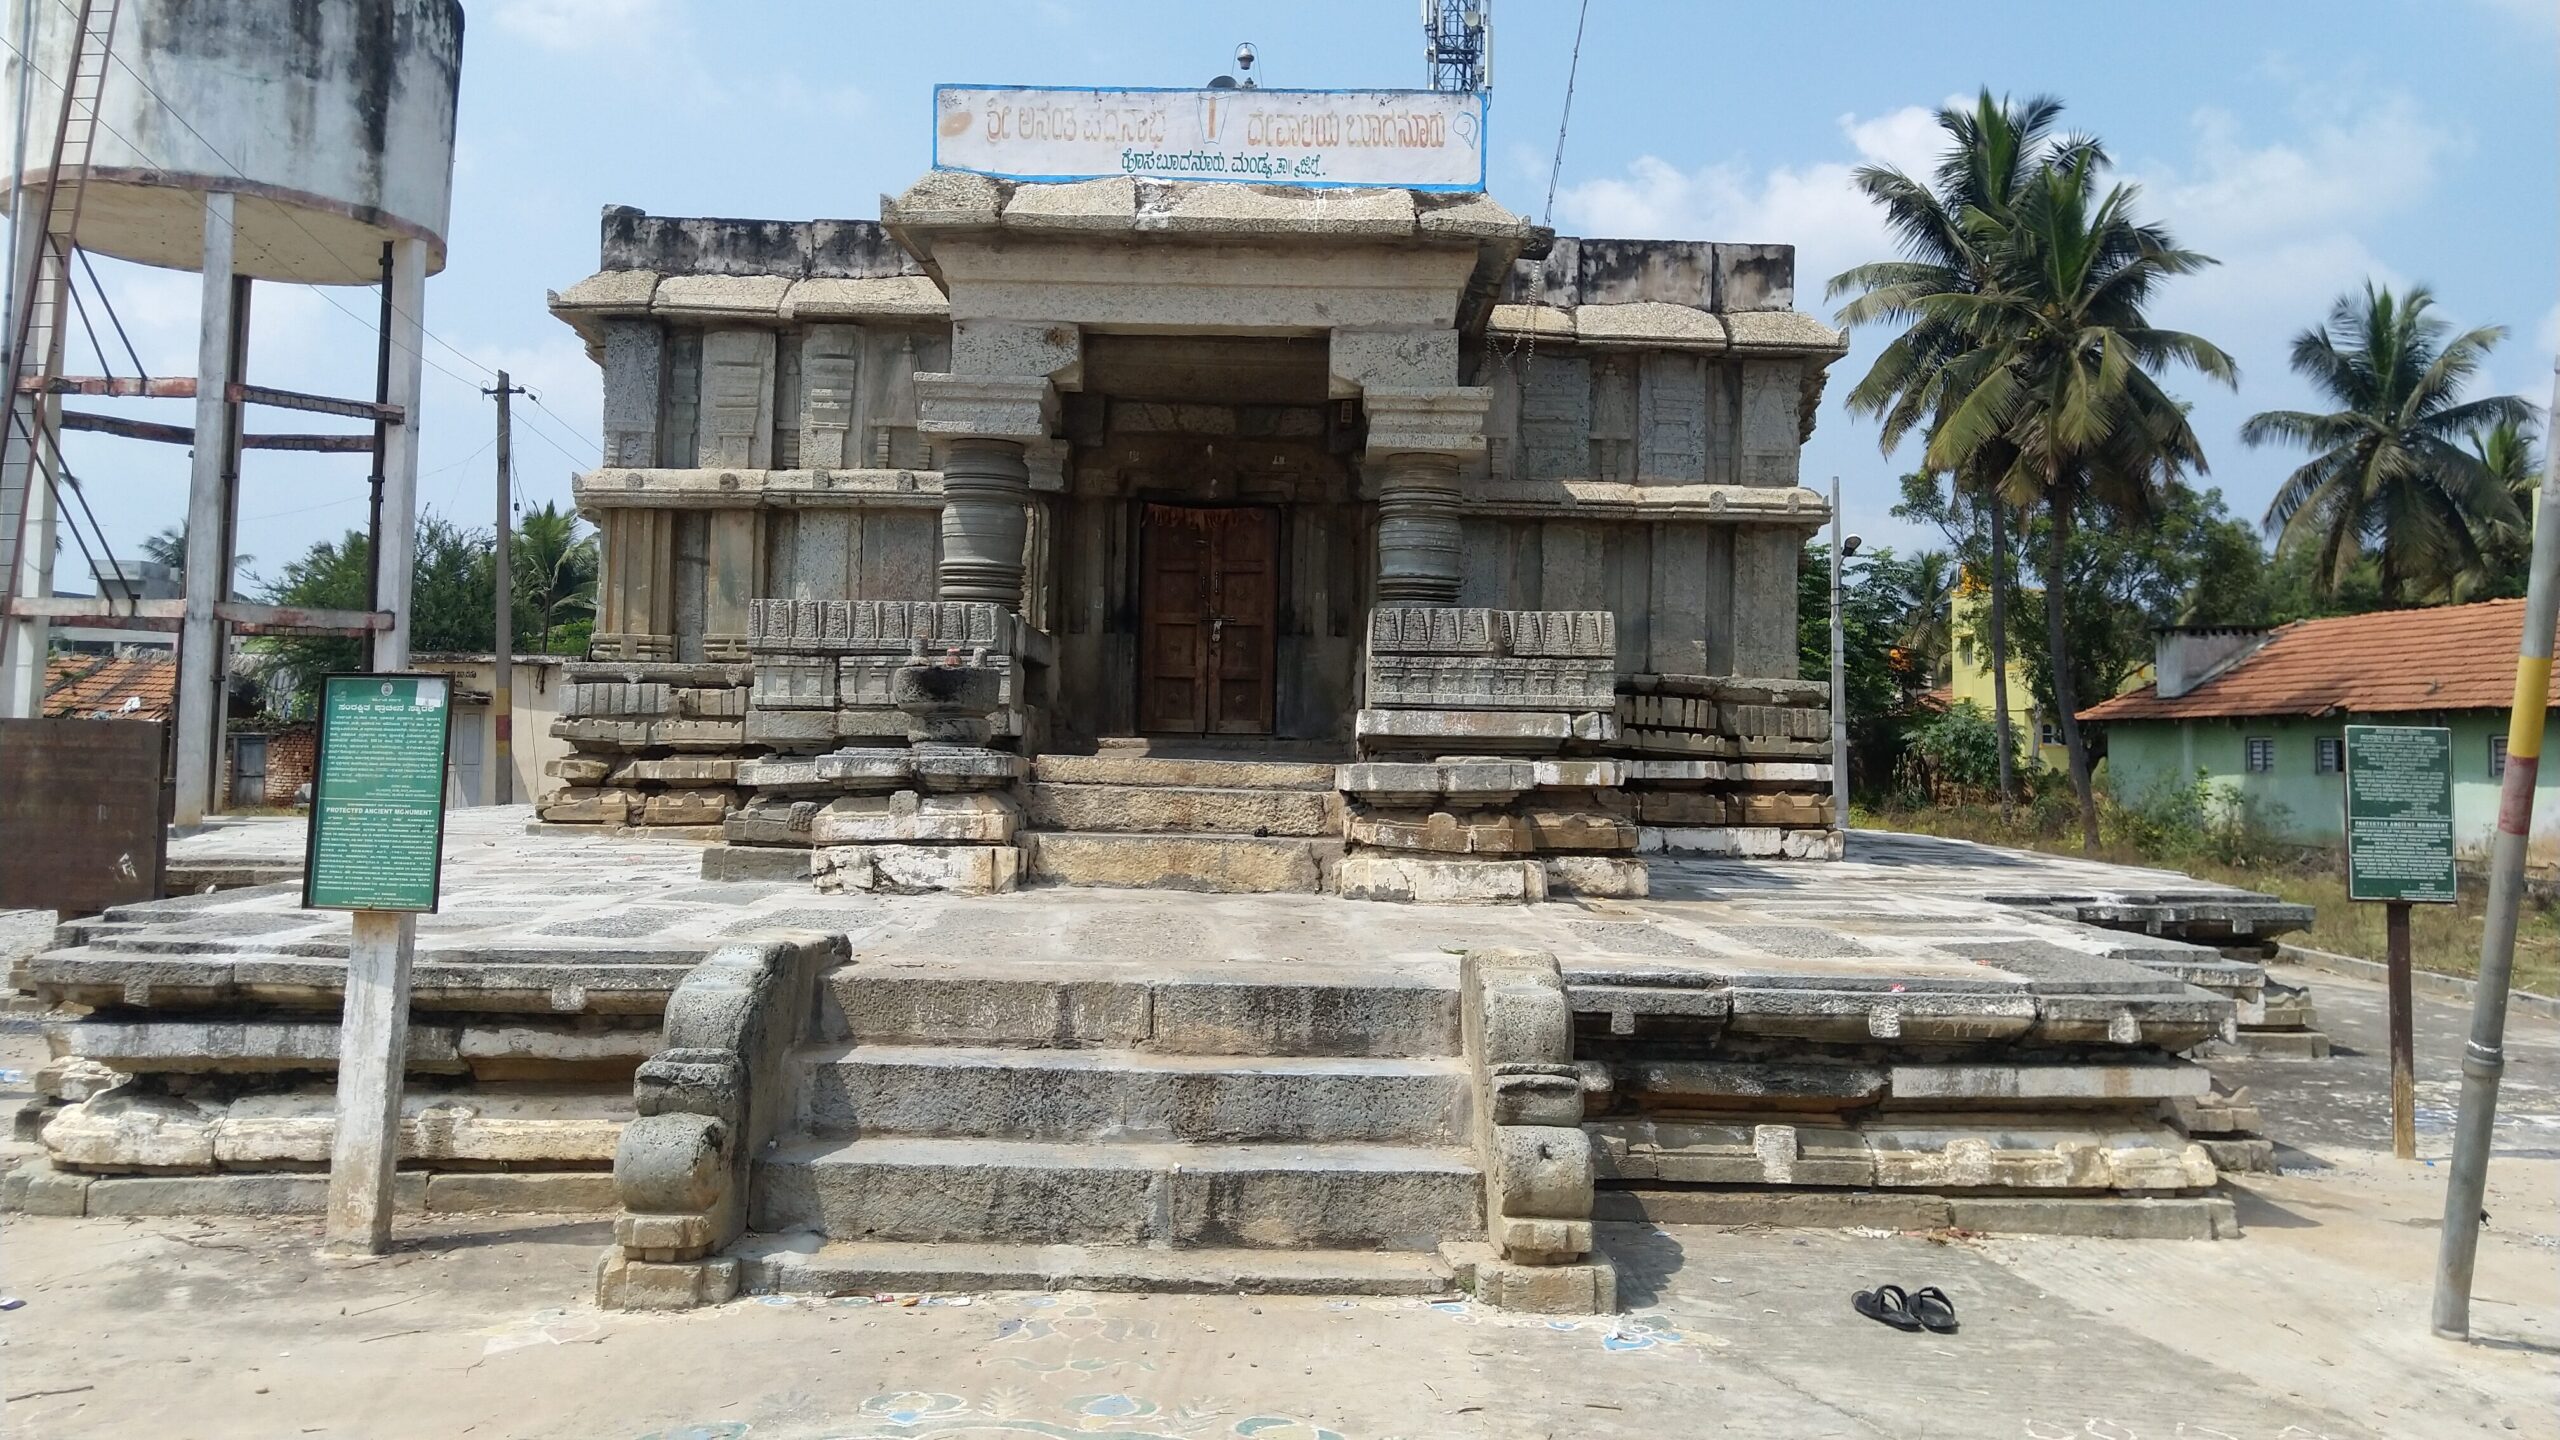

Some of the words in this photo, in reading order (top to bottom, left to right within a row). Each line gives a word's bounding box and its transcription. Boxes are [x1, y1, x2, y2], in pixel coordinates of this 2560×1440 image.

[986, 97, 1012, 145] ಶ್ರೀ
[1018, 101, 1077, 142] ಅನಂತ
[1247, 106, 1340, 147] ದೇವಾಲಯ
